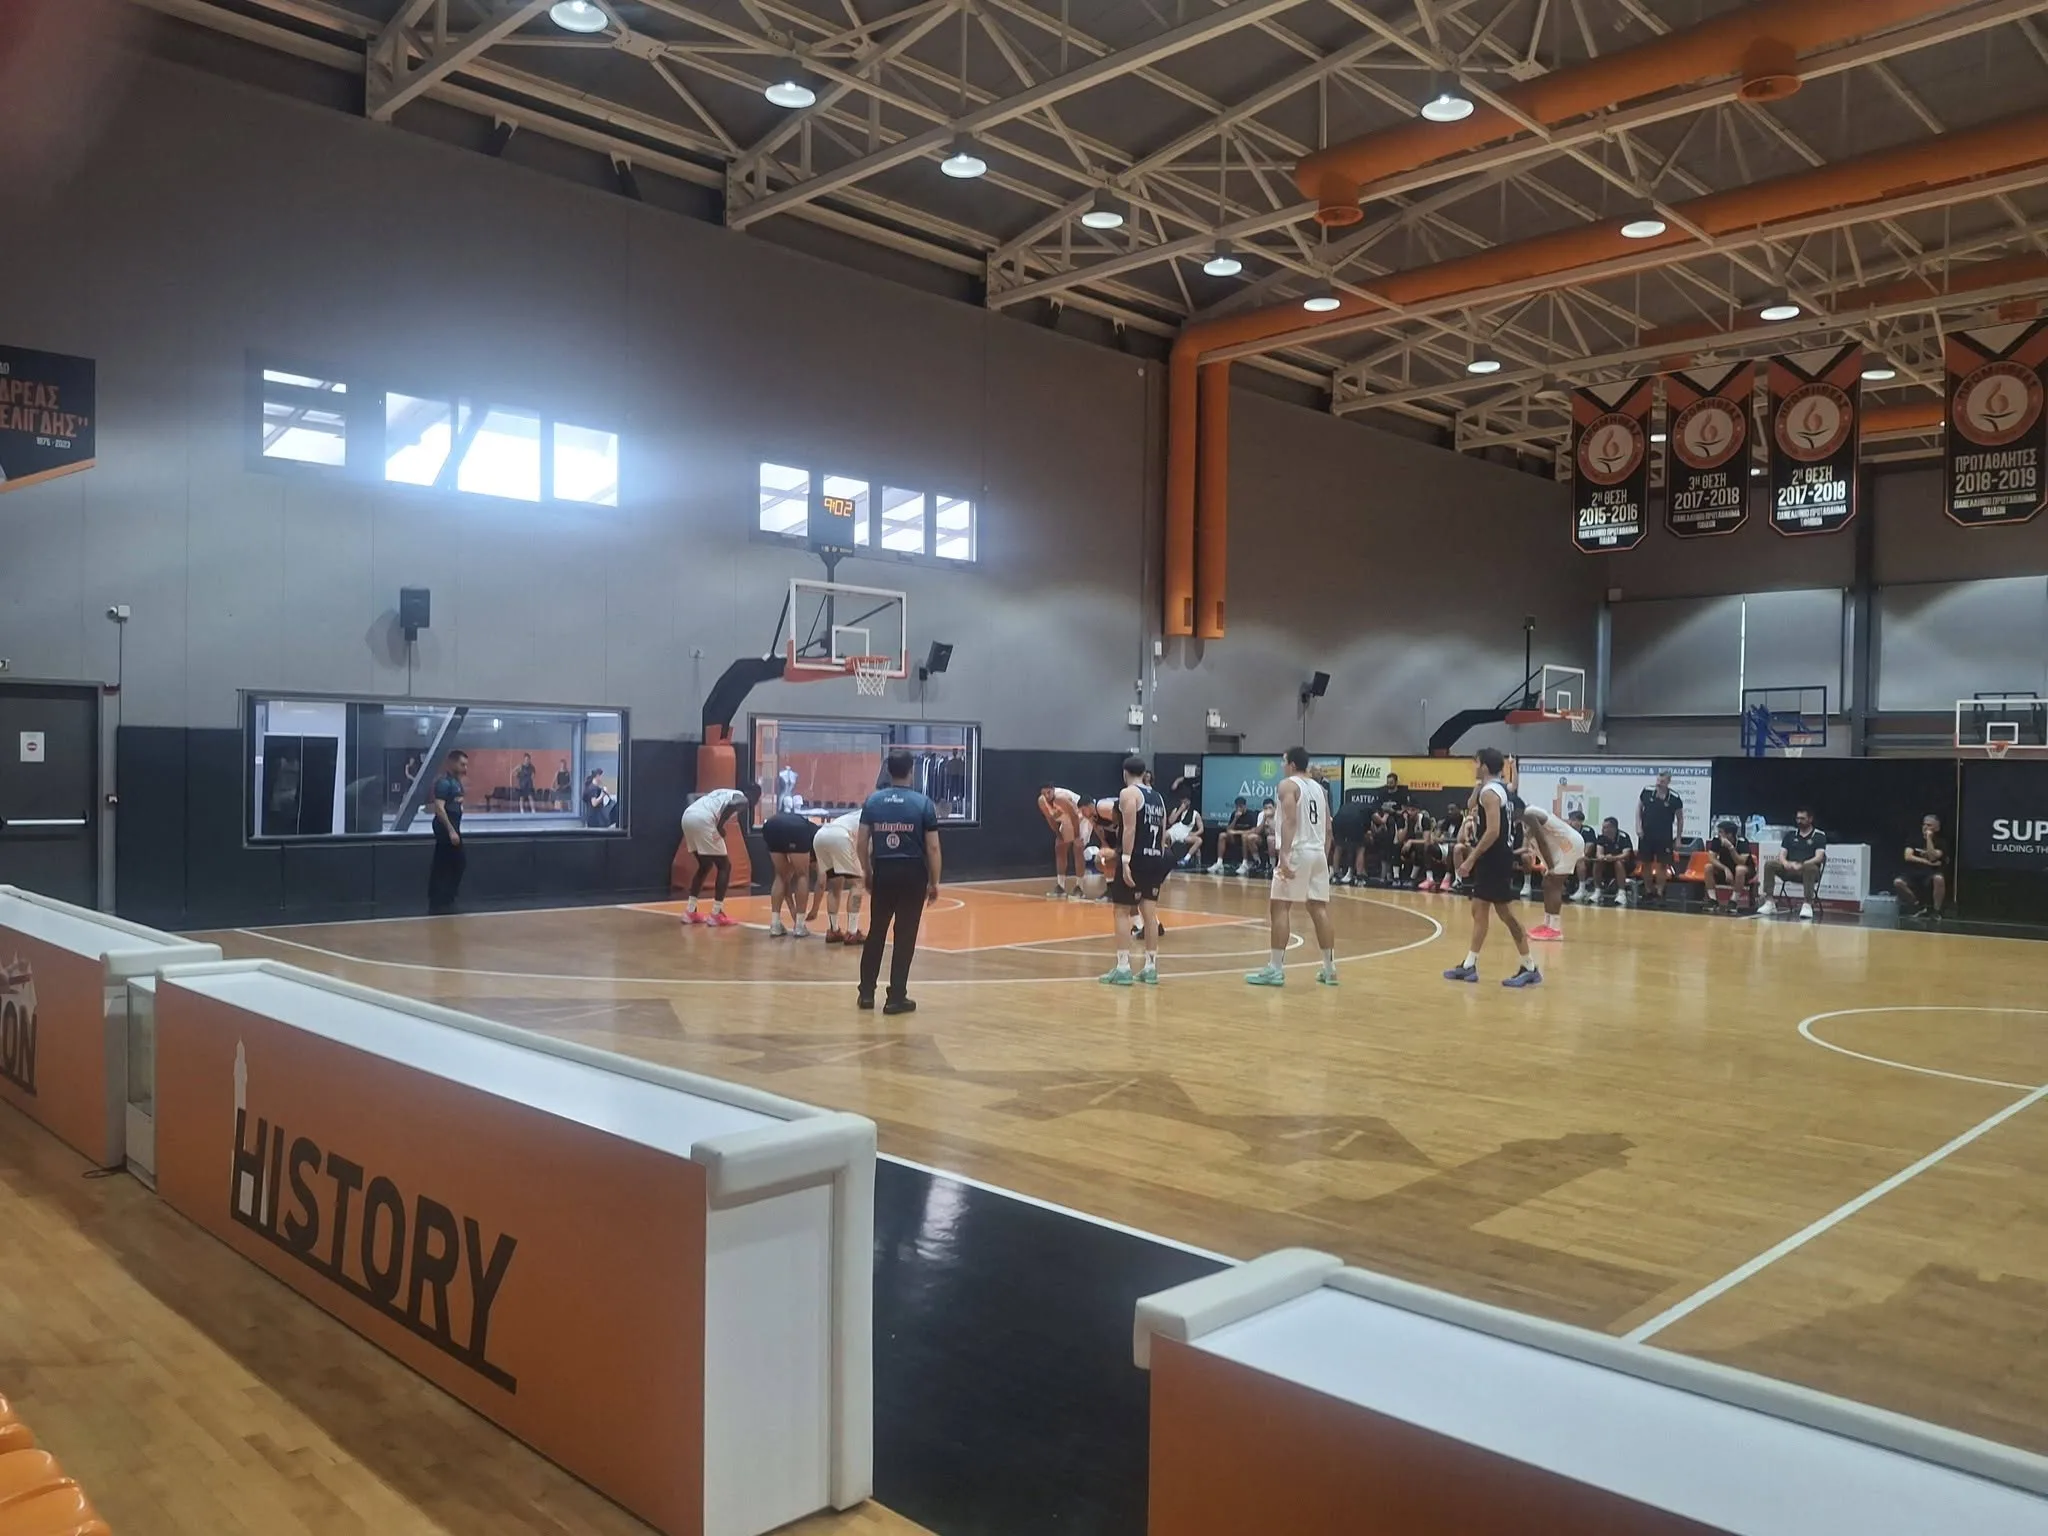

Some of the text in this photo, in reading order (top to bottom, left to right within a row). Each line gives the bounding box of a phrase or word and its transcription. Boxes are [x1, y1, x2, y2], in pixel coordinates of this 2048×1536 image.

[0, 376, 60, 410] ΔΡΕΑΣ
[1955, 448, 2037, 473] ΠΡΩΤΑΘΛΗΤΕΣ
[1702, 472, 1727, 489] ΘΕΣΗ
[1805, 465, 1833, 483] ΘΕΣΗ
[1955, 467, 2036, 494] 2018-2019
[1604, 488, 1627, 505] ΘΕΣΗ
[1674, 487, 1740, 510] 2017-2018
[1777, 480, 1846, 507] 2017-2018
[1579, 503, 1638, 526] 2015-2016
[1605, 766, 1646, 774] ΘΕΡΑΠΕΙΩΝ
[1239, 780, 1277, 798] Δίδυ
[1309, 800, 1318, 825] 8
[1149, 824, 1159, 850] 7
[1992, 818, 2048, 841] SUP
[1991, 843, 2034, 854] LEADING
[231, 1107, 518, 1368] HISTORY
